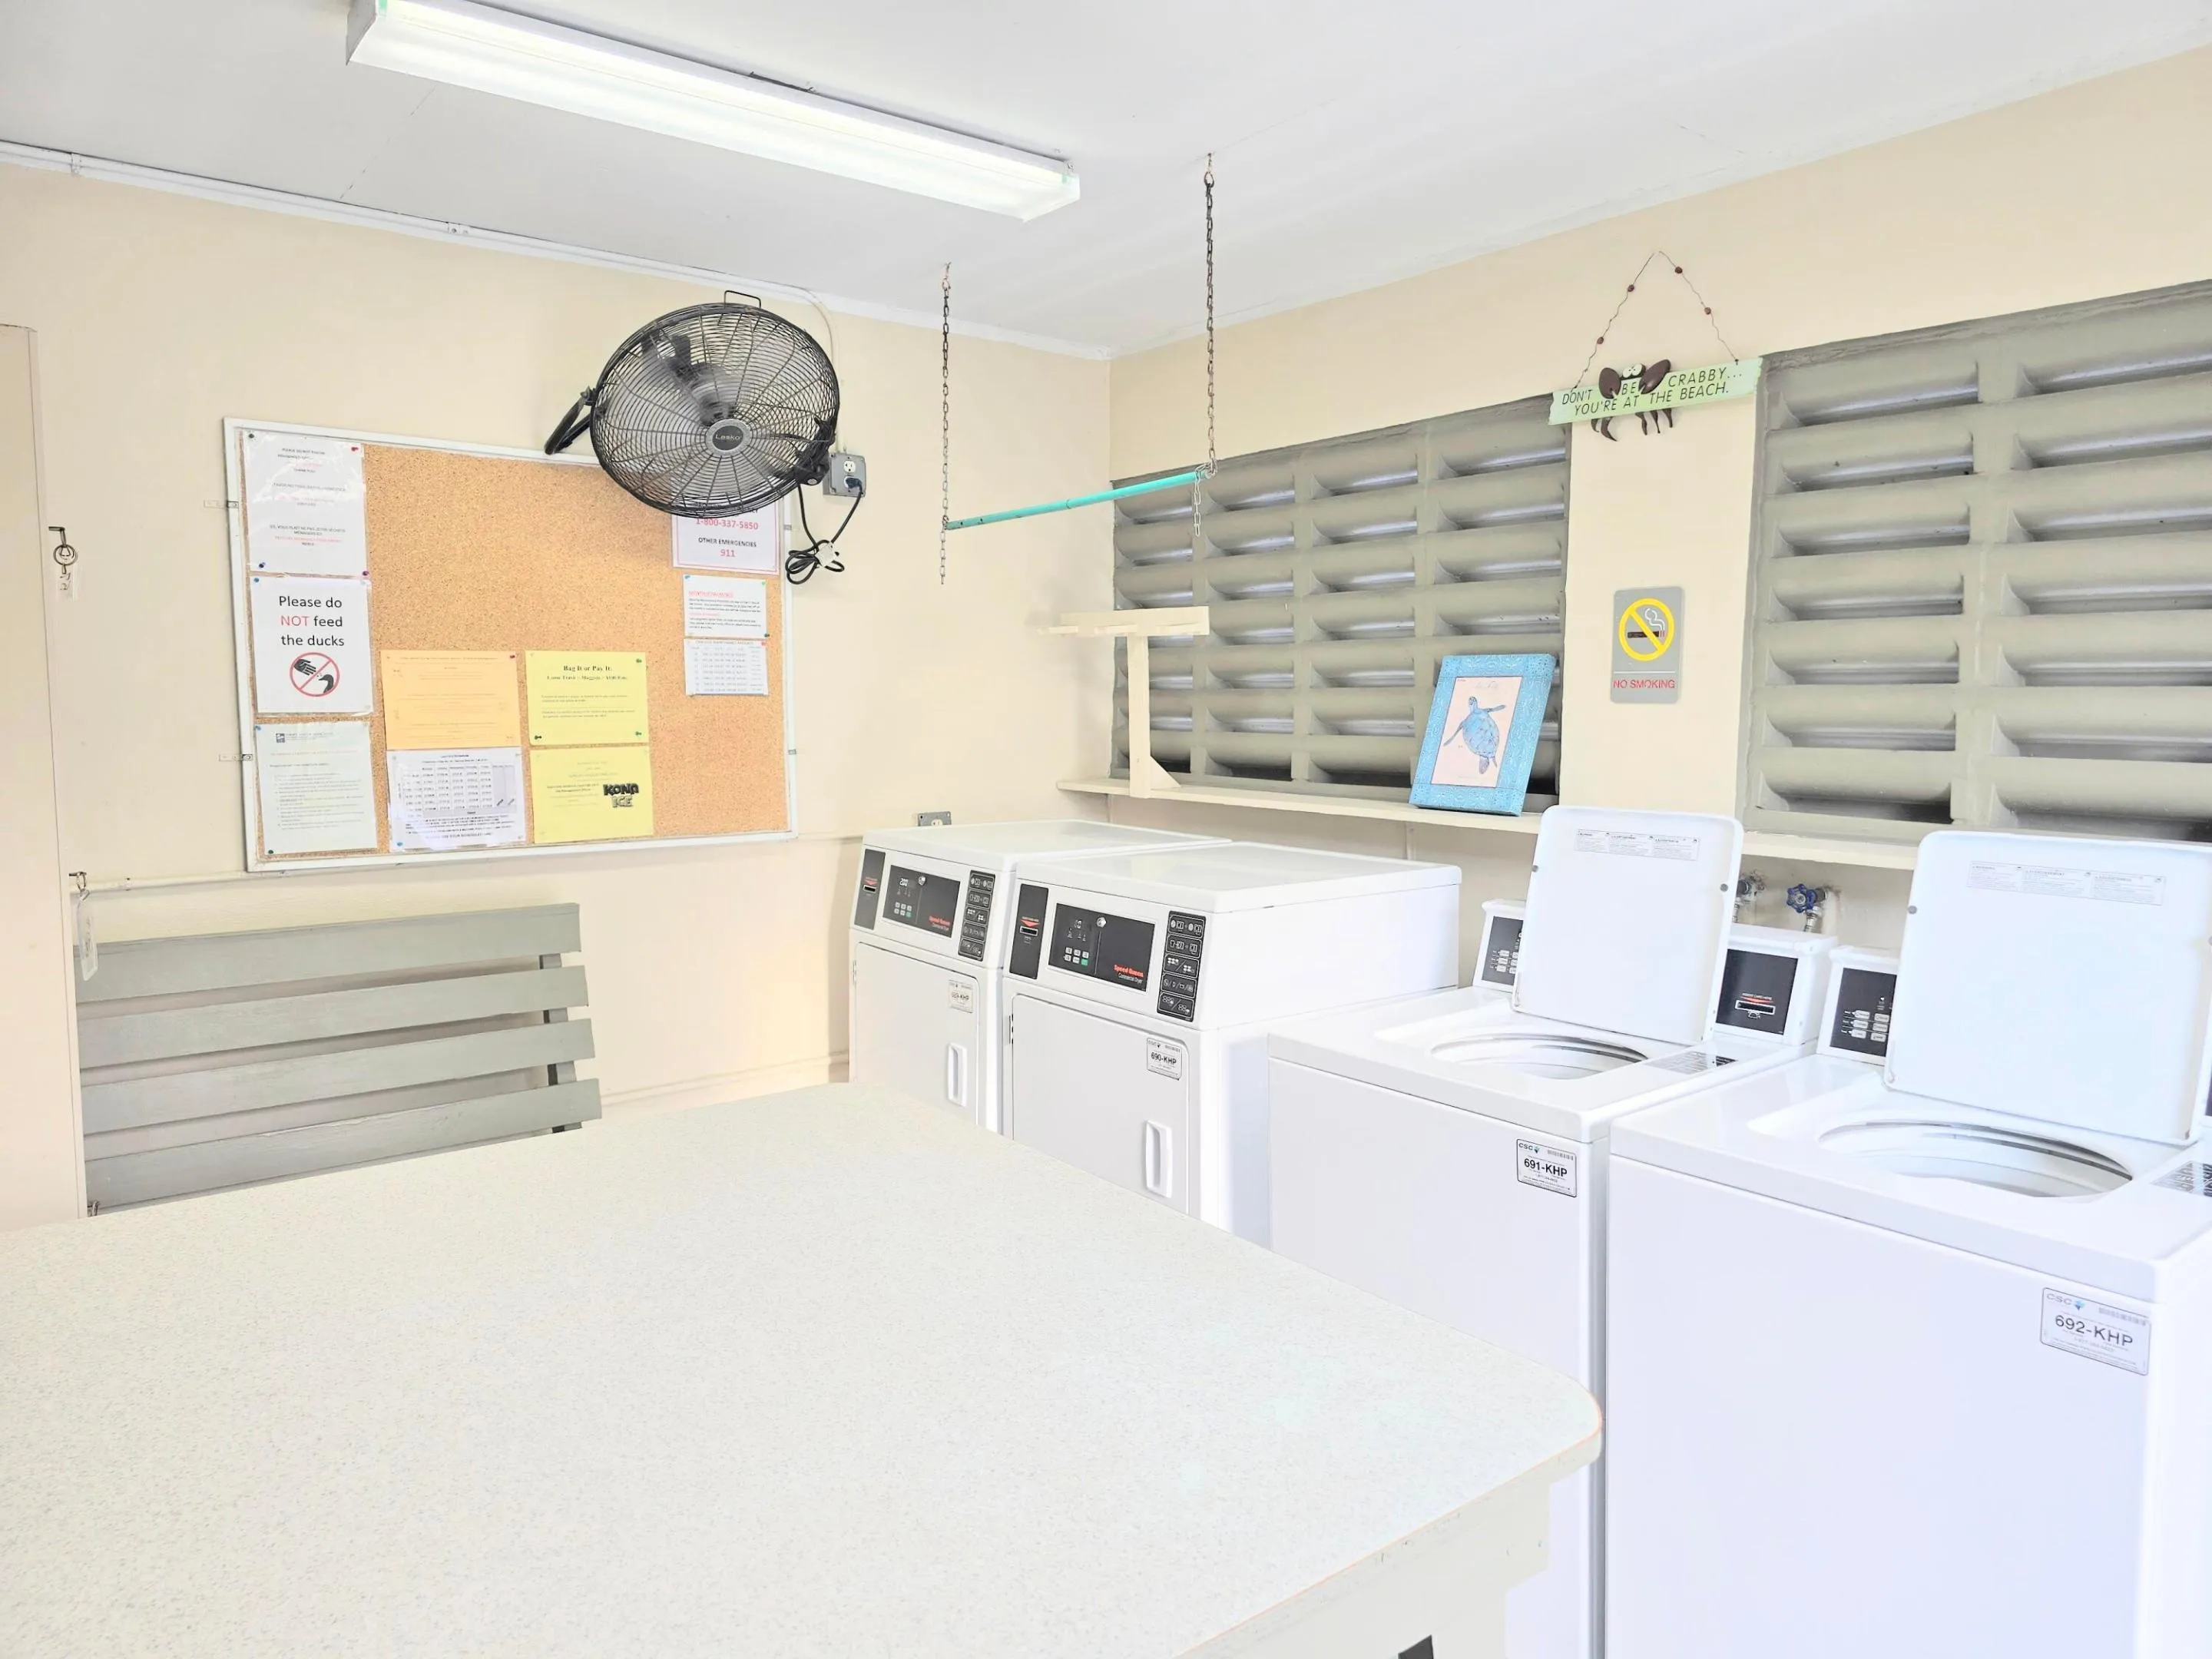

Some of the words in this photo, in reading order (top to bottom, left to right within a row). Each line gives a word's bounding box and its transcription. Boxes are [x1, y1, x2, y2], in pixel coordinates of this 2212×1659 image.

[1561, 389, 1593, 406] DON'T
[1621, 382, 1637, 396] BE
[1575, 398, 1617, 416] YOU'RE
[1623, 395, 1641, 409] AT
[1649, 390, 1673, 405] THE
[1680, 381, 1729, 401] BEACH.
[696, 518, 759, 530] 1-800-337-5850
[718, 538, 757, 548] EMERGENCIES
[720, 548, 736, 558] 911
[279, 595, 322, 608] Please
[326, 597, 343, 608] do
[280, 615, 310, 626] NOT
[313, 615, 343, 627] feed
[281, 634, 303, 645] the
[307, 634, 345, 647] ducks
[1613, 679, 1628, 689] NO
[1630, 679, 1675, 689] SMOKING
[602, 783, 640, 796] KONA
[611, 795, 634, 808] ICE
[1151, 1051, 1177, 1065] 690-KHP
[1518, 1142, 1533, 1151] CSC
[1524, 1157, 1568, 1177] 691-KHP
[2046, 1293, 2073, 1306] CSC
[2055, 1314, 2134, 1346] 692-KHP
